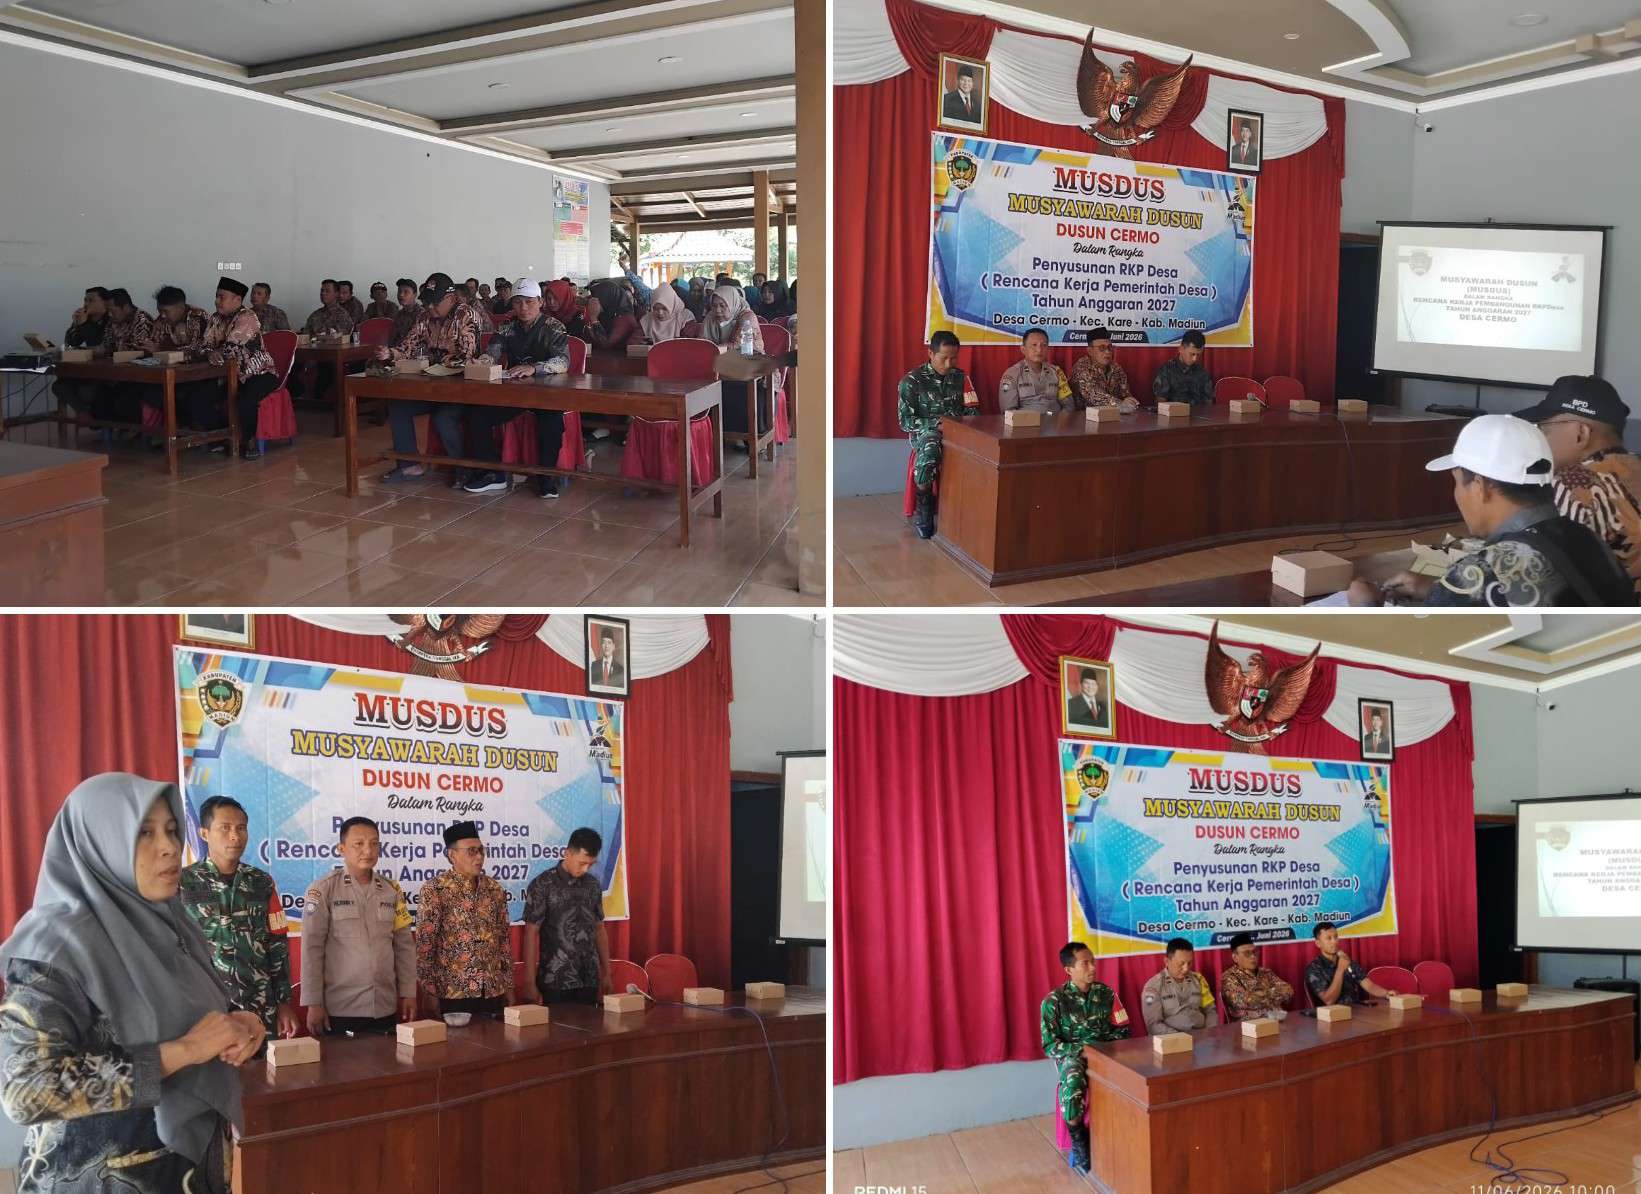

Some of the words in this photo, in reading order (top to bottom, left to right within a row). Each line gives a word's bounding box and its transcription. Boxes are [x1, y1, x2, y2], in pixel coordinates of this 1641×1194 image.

[1053, 167, 1165, 202] MUSDUS
[1008, 193, 1142, 224] MUSYAWARAH
[1146, 208, 1203, 229] DUSUN
[1056, 223, 1106, 240] DUSUN
[1110, 228, 1160, 244] CERMO
[1073, 242, 1107, 255] Dalam
[1108, 245, 1144, 260] Rangka
[1032, 257, 1115, 275] Penyusunan
[1120, 263, 1144, 276] RKP
[1148, 265, 1178, 278] Desa
[993, 274, 1059, 289] Rencana
[1064, 277, 1099, 293] Kerja
[1104, 280, 1175, 294] Pemerintah
[1179, 284, 1208, 296] Desa
[1032, 294, 1074, 308] Tahun
[1078, 296, 1143, 312] Anggaran
[1147, 299, 1176, 311] 2027
[993, 313, 1025, 325] Desa
[1029, 314, 1070, 326] Cermo
[1080, 316, 1104, 326] Kec.
[1108, 317, 1132, 327] Kare
[1142, 318, 1165, 328] Kab.
[1168, 319, 1205, 329] Madiun
[1459, 313, 1483, 322] DESA
[1485, 315, 1518, 323] CERMO
[353, 692, 507, 738] MUSDUS
[290, 729, 480, 768] MUSYAWARAH
[484, 746, 559, 773] DUSUN
[362, 769, 431, 790] DUSUN
[437, 773, 504, 793] CERMO
[1188, 768, 1303, 798] MUSDUS
[387, 794, 433, 811] Dalam
[436, 797, 484, 816] Rangka
[1143, 798, 1281, 820] MUSYAWARAH
[1284, 804, 1341, 822] DUSUN
[490, 821, 530, 837] Desa
[1195, 825, 1246, 839] DUSUN
[1250, 826, 1300, 840] CERMO
[1214, 843, 1248, 855] Dalam
[1249, 844, 1285, 858] Rangka
[492, 864, 529, 880] 2027
[1173, 861, 1258, 877] Penyusunan
[1262, 861, 1286, 873] RKP
[1290, 861, 1320, 872] Desa
[1134, 881, 1202, 895] Rencana
[1207, 879, 1243, 895] Kerja
[1247, 878, 1318, 891] Pemerintah
[1322, 876, 1351, 888] Desa
[1176, 898, 1219, 912] Tahun
[1223, 897, 1288, 912] Anggaran
[1292, 894, 1320, 906] 2027
[1138, 922, 1171, 933] Desa
[1174, 919, 1216, 931] Cermo
[1226, 917, 1250, 927] Kec.
[1254, 915, 1278, 926] Kare
[1288, 913, 1311, 923] Kab.
[1314, 911, 1351, 922] Madiun
[1257, 931, 1272, 940] Juni
